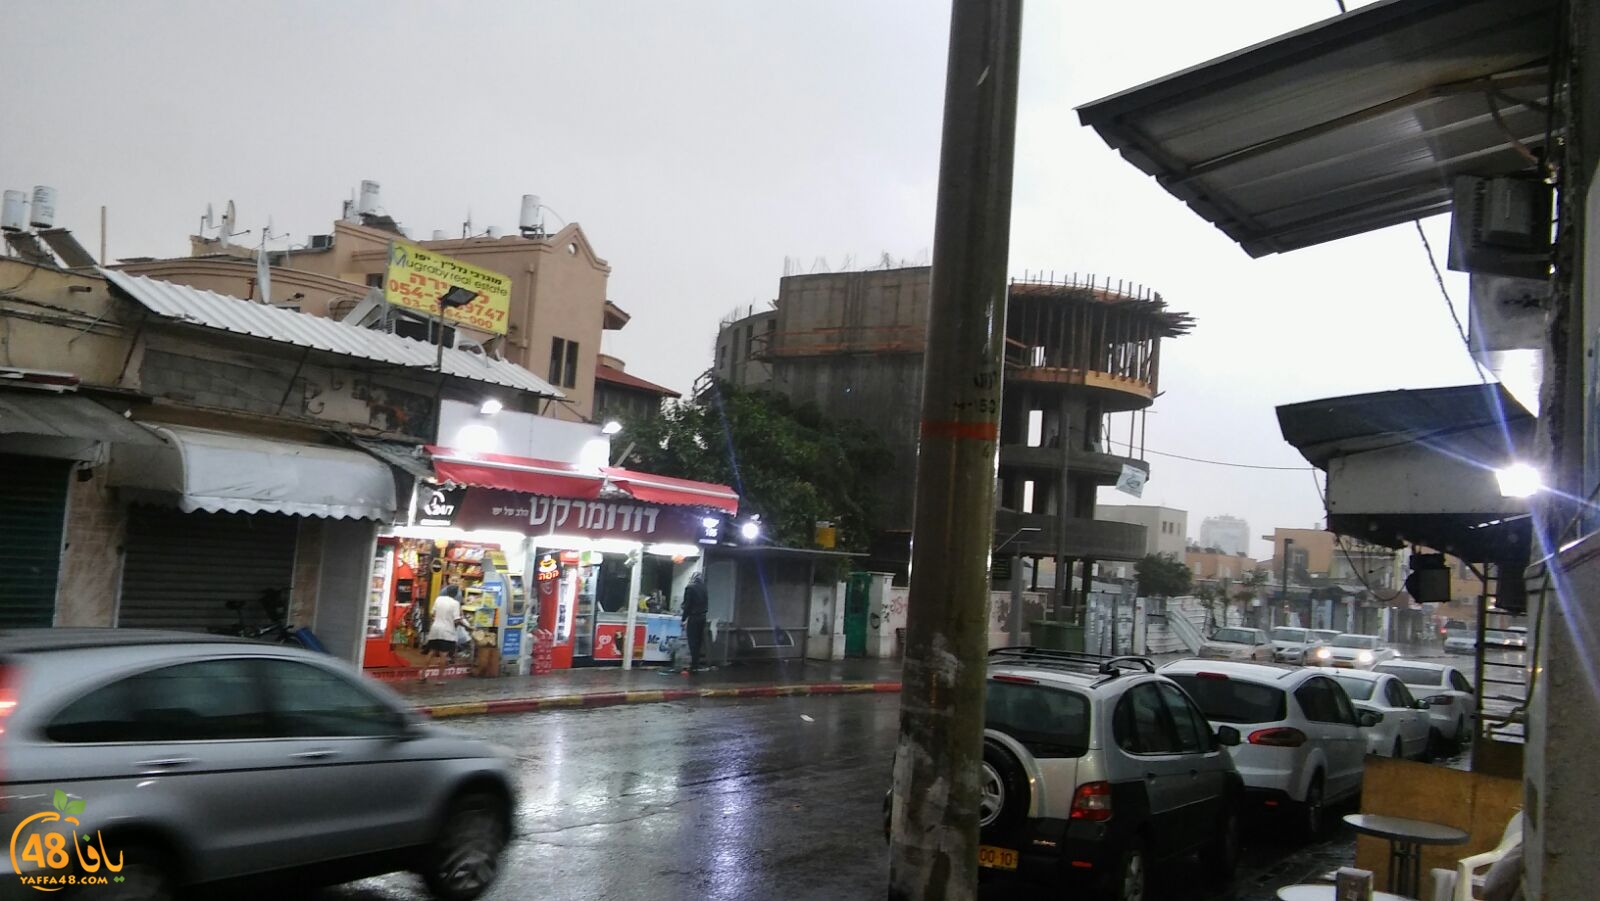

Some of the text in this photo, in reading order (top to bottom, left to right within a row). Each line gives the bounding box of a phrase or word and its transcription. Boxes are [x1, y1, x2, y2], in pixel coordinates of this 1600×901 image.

[394, 246, 508, 296] Mugraby real estate
[530, 496, 661, 535] דודומרקט
